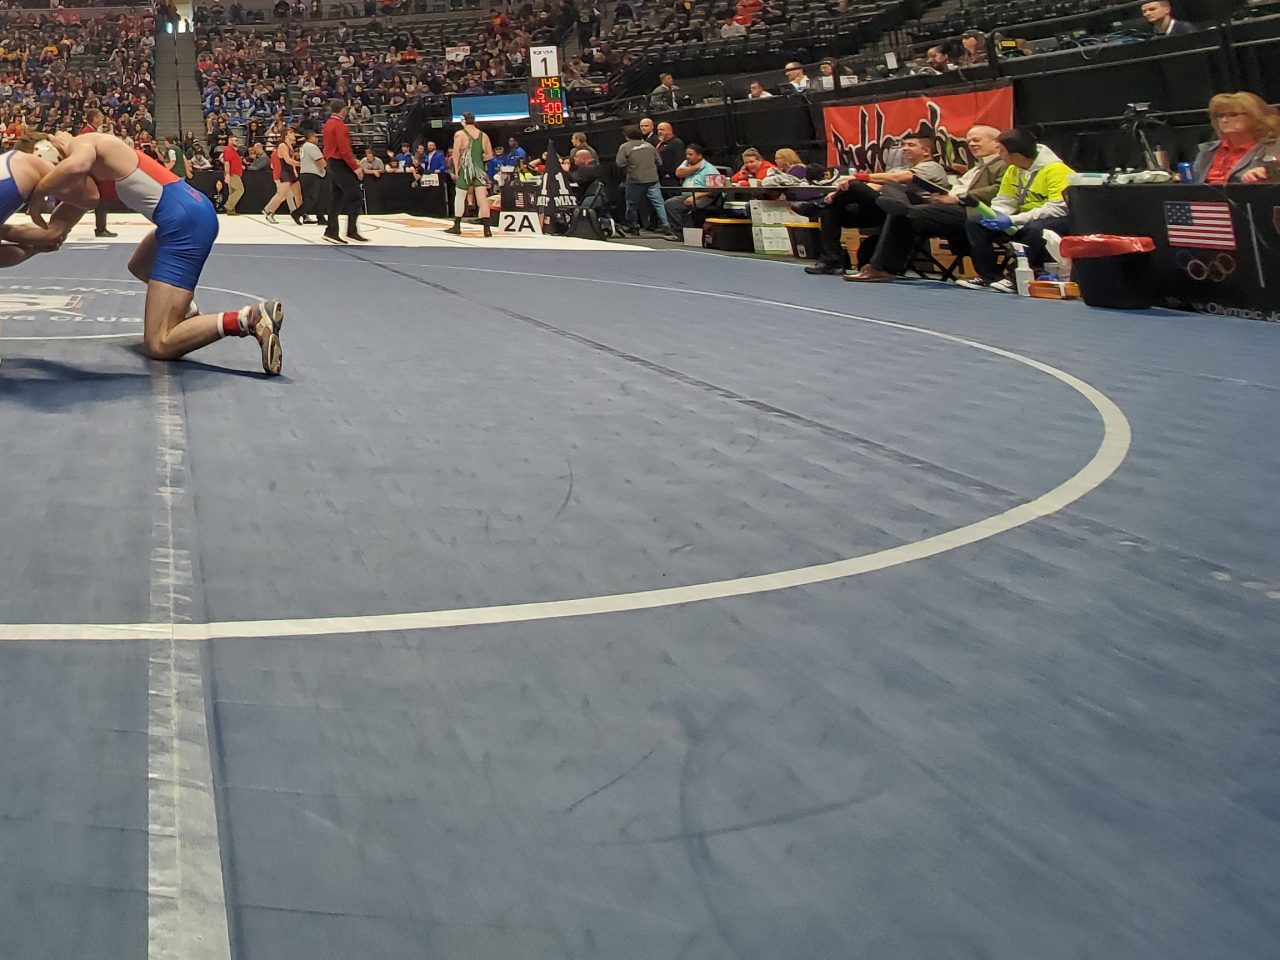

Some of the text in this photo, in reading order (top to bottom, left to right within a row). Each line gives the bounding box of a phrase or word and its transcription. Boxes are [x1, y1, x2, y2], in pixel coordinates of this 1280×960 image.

[540, 57, 548, 76] 1
[541, 77, 560, 88] 145
[543, 113, 563, 125] 160
[554, 171, 570, 195] 1
[553, 195, 578, 207] MAT
[503, 214, 536, 233] 2A
